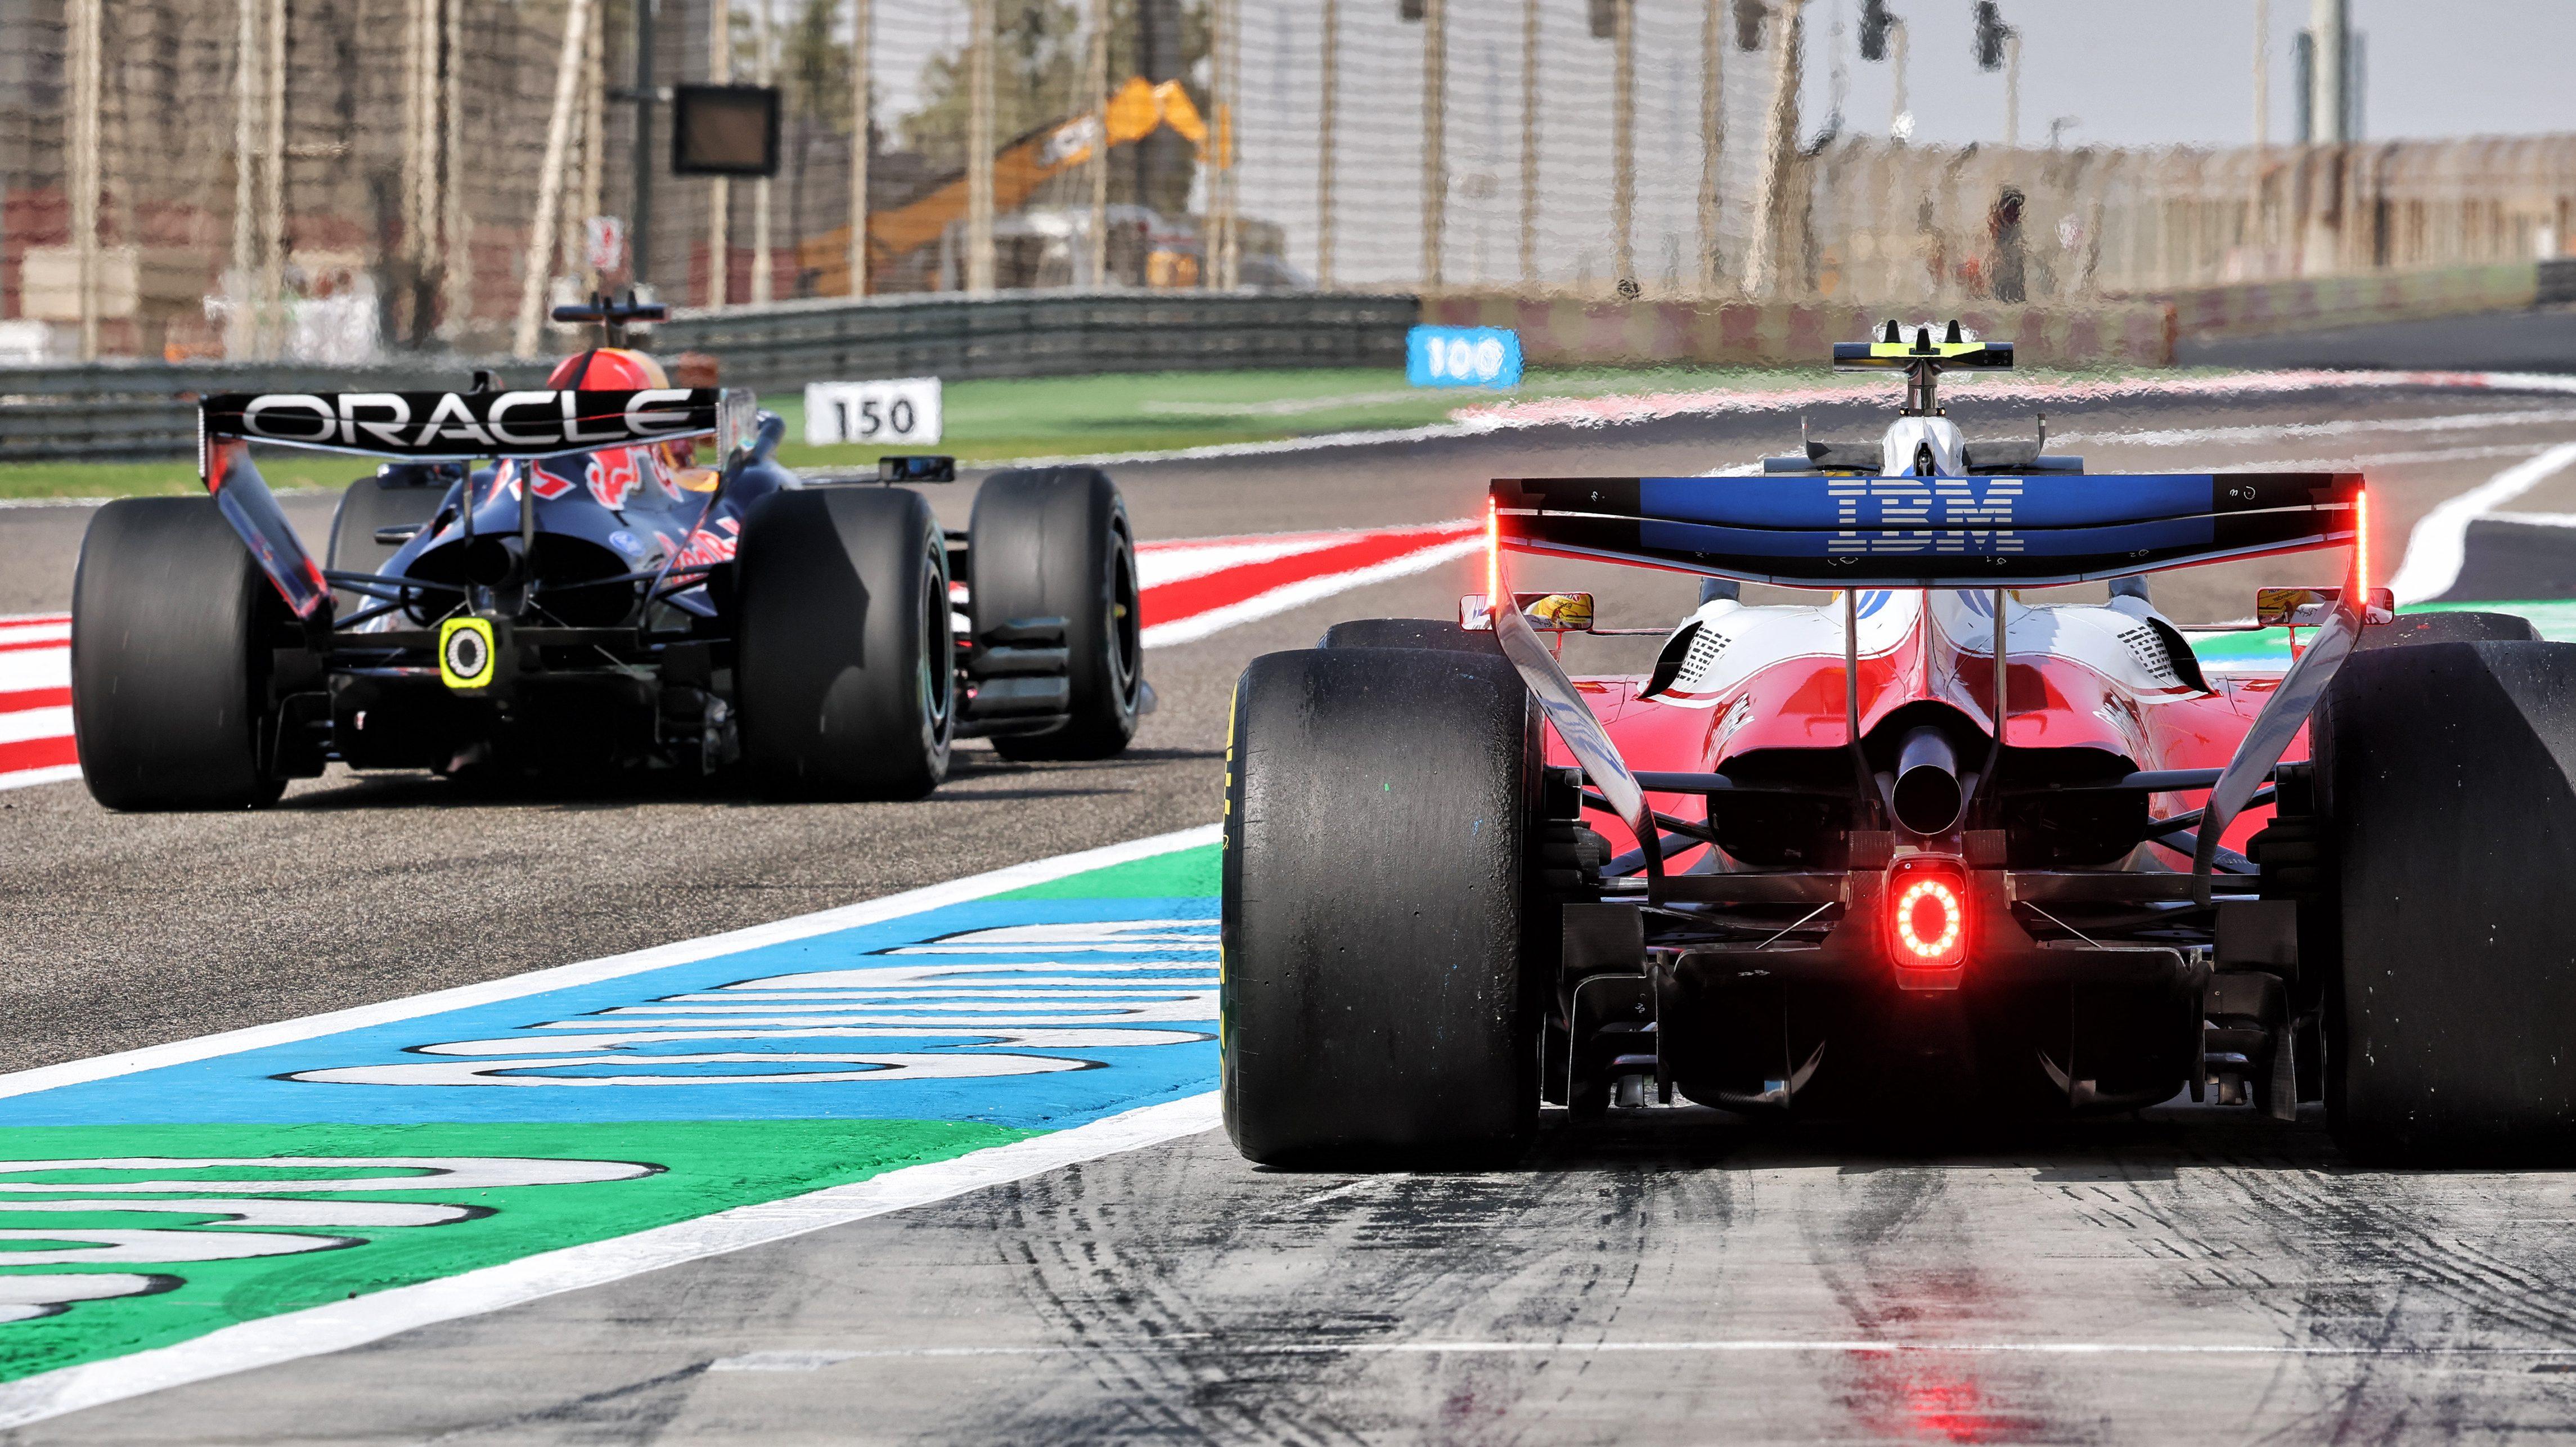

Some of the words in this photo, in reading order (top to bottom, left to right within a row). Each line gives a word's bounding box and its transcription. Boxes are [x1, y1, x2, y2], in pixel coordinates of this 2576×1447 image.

[1426, 338, 1505, 380] 100
[242, 388, 693, 445] ORACLE
[834, 398, 914, 439] 150
[1828, 479, 2024, 551] IBM
